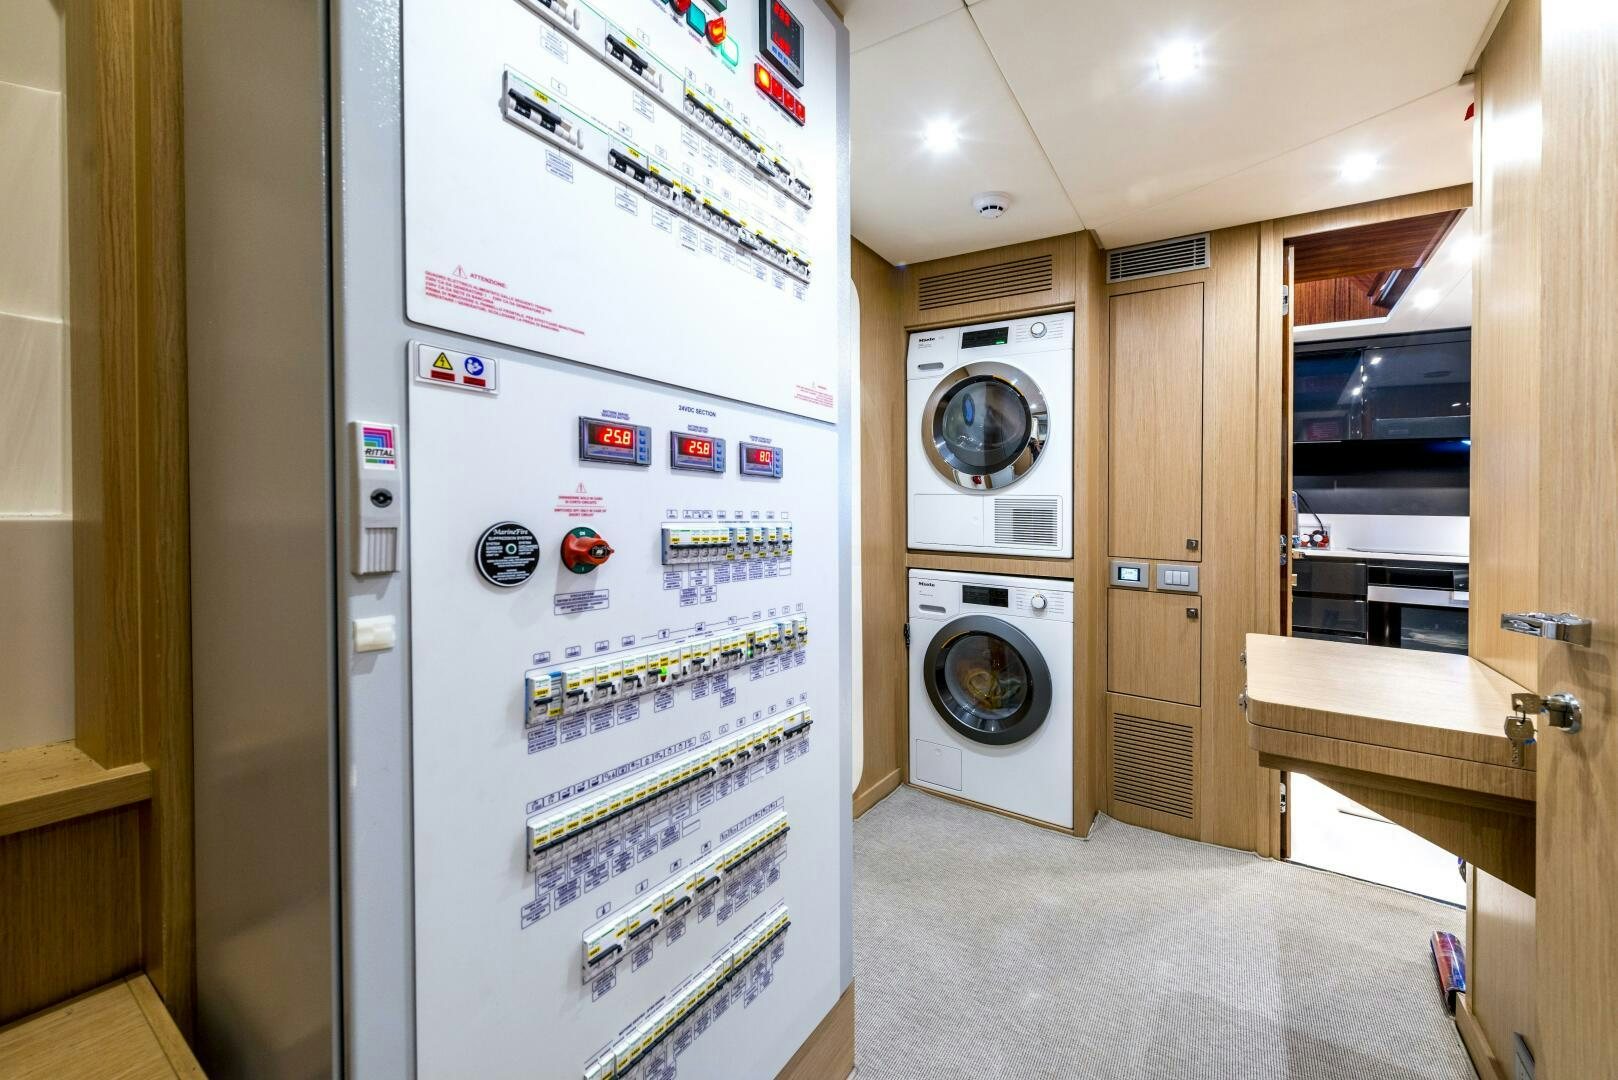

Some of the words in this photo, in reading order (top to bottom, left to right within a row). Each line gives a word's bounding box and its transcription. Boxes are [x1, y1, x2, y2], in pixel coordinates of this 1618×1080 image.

[678, 404, 695, 414] 24VDC
[695, 406, 717, 418] SECTION
[603, 427, 631, 445] 25.8
[365, 448, 394, 457] RITTAL
[688, 440, 710, 455] 25.8
